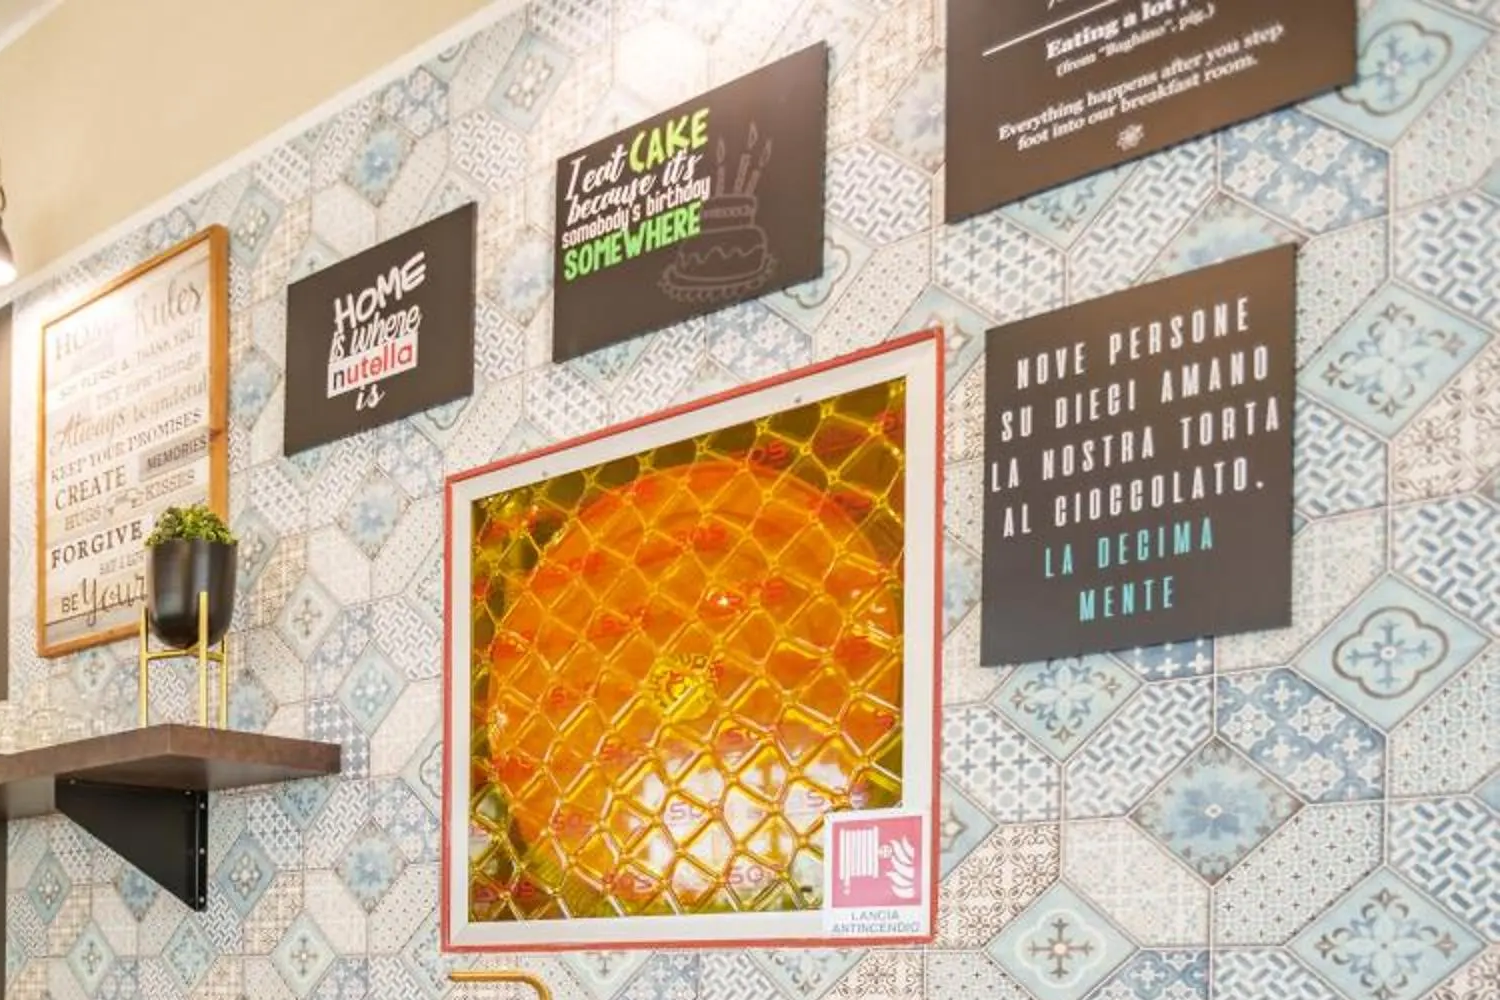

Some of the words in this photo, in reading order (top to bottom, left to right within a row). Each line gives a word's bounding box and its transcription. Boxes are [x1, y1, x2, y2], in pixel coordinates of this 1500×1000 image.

[1045, 17, 1120, 60] Eating
[1122, 12, 1138, 29] a
[998, 98, 1085, 141] Everything
[1086, 72, 1158, 106] happens
[1161, 52, 1204, 84] after
[1204, 41, 1240, 66] you
[1243, 21, 1285, 48] step
[1017, 127, 1049, 151] foot
[1052, 117, 1085, 140] into
[1087, 105, 1116, 126] our
[1120, 72, 1201, 114] breakfast
[1203, 54, 1258, 83] room.
[565, 155, 587, 201] I
[583, 143, 628, 192] eat
[629, 107, 711, 174] CAKE
[566, 175, 659, 227] because
[662, 148, 704, 188] it's
[562, 202, 641, 250] somebody's
[646, 176, 712, 217] birthday
[563, 201, 702, 282] SOMEWHERE
[334, 250, 427, 334] HOME
[350, 304, 423, 355] where
[1016, 342, 1087, 390] NOVE
[1108, 297, 1249, 367] PERSONE
[332, 343, 414, 391] nutella
[355, 384, 387, 411] is
[1000, 405, 1033, 442] SU
[1055, 379, 1137, 430] DIECI
[1160, 345, 1269, 404] AMANO
[55, 465, 127, 512] CREATE
[147, 433, 208, 470] MEMORIES
[991, 457, 1020, 493] LA
[1041, 426, 1155, 481] NOSTRA
[1179, 397, 1280, 450] TORTA
[51, 519, 144, 570] FORGIVE
[1003, 502, 1032, 538] AL
[1044, 543, 1074, 578] LA
[1097, 517, 1214, 569] DECIMA
[60, 592, 79, 614] BE
[1078, 575, 1174, 622] MENTE
[831, 921, 920, 934] ANTINCENDIO
[850, 909, 900, 921] LANCIA
